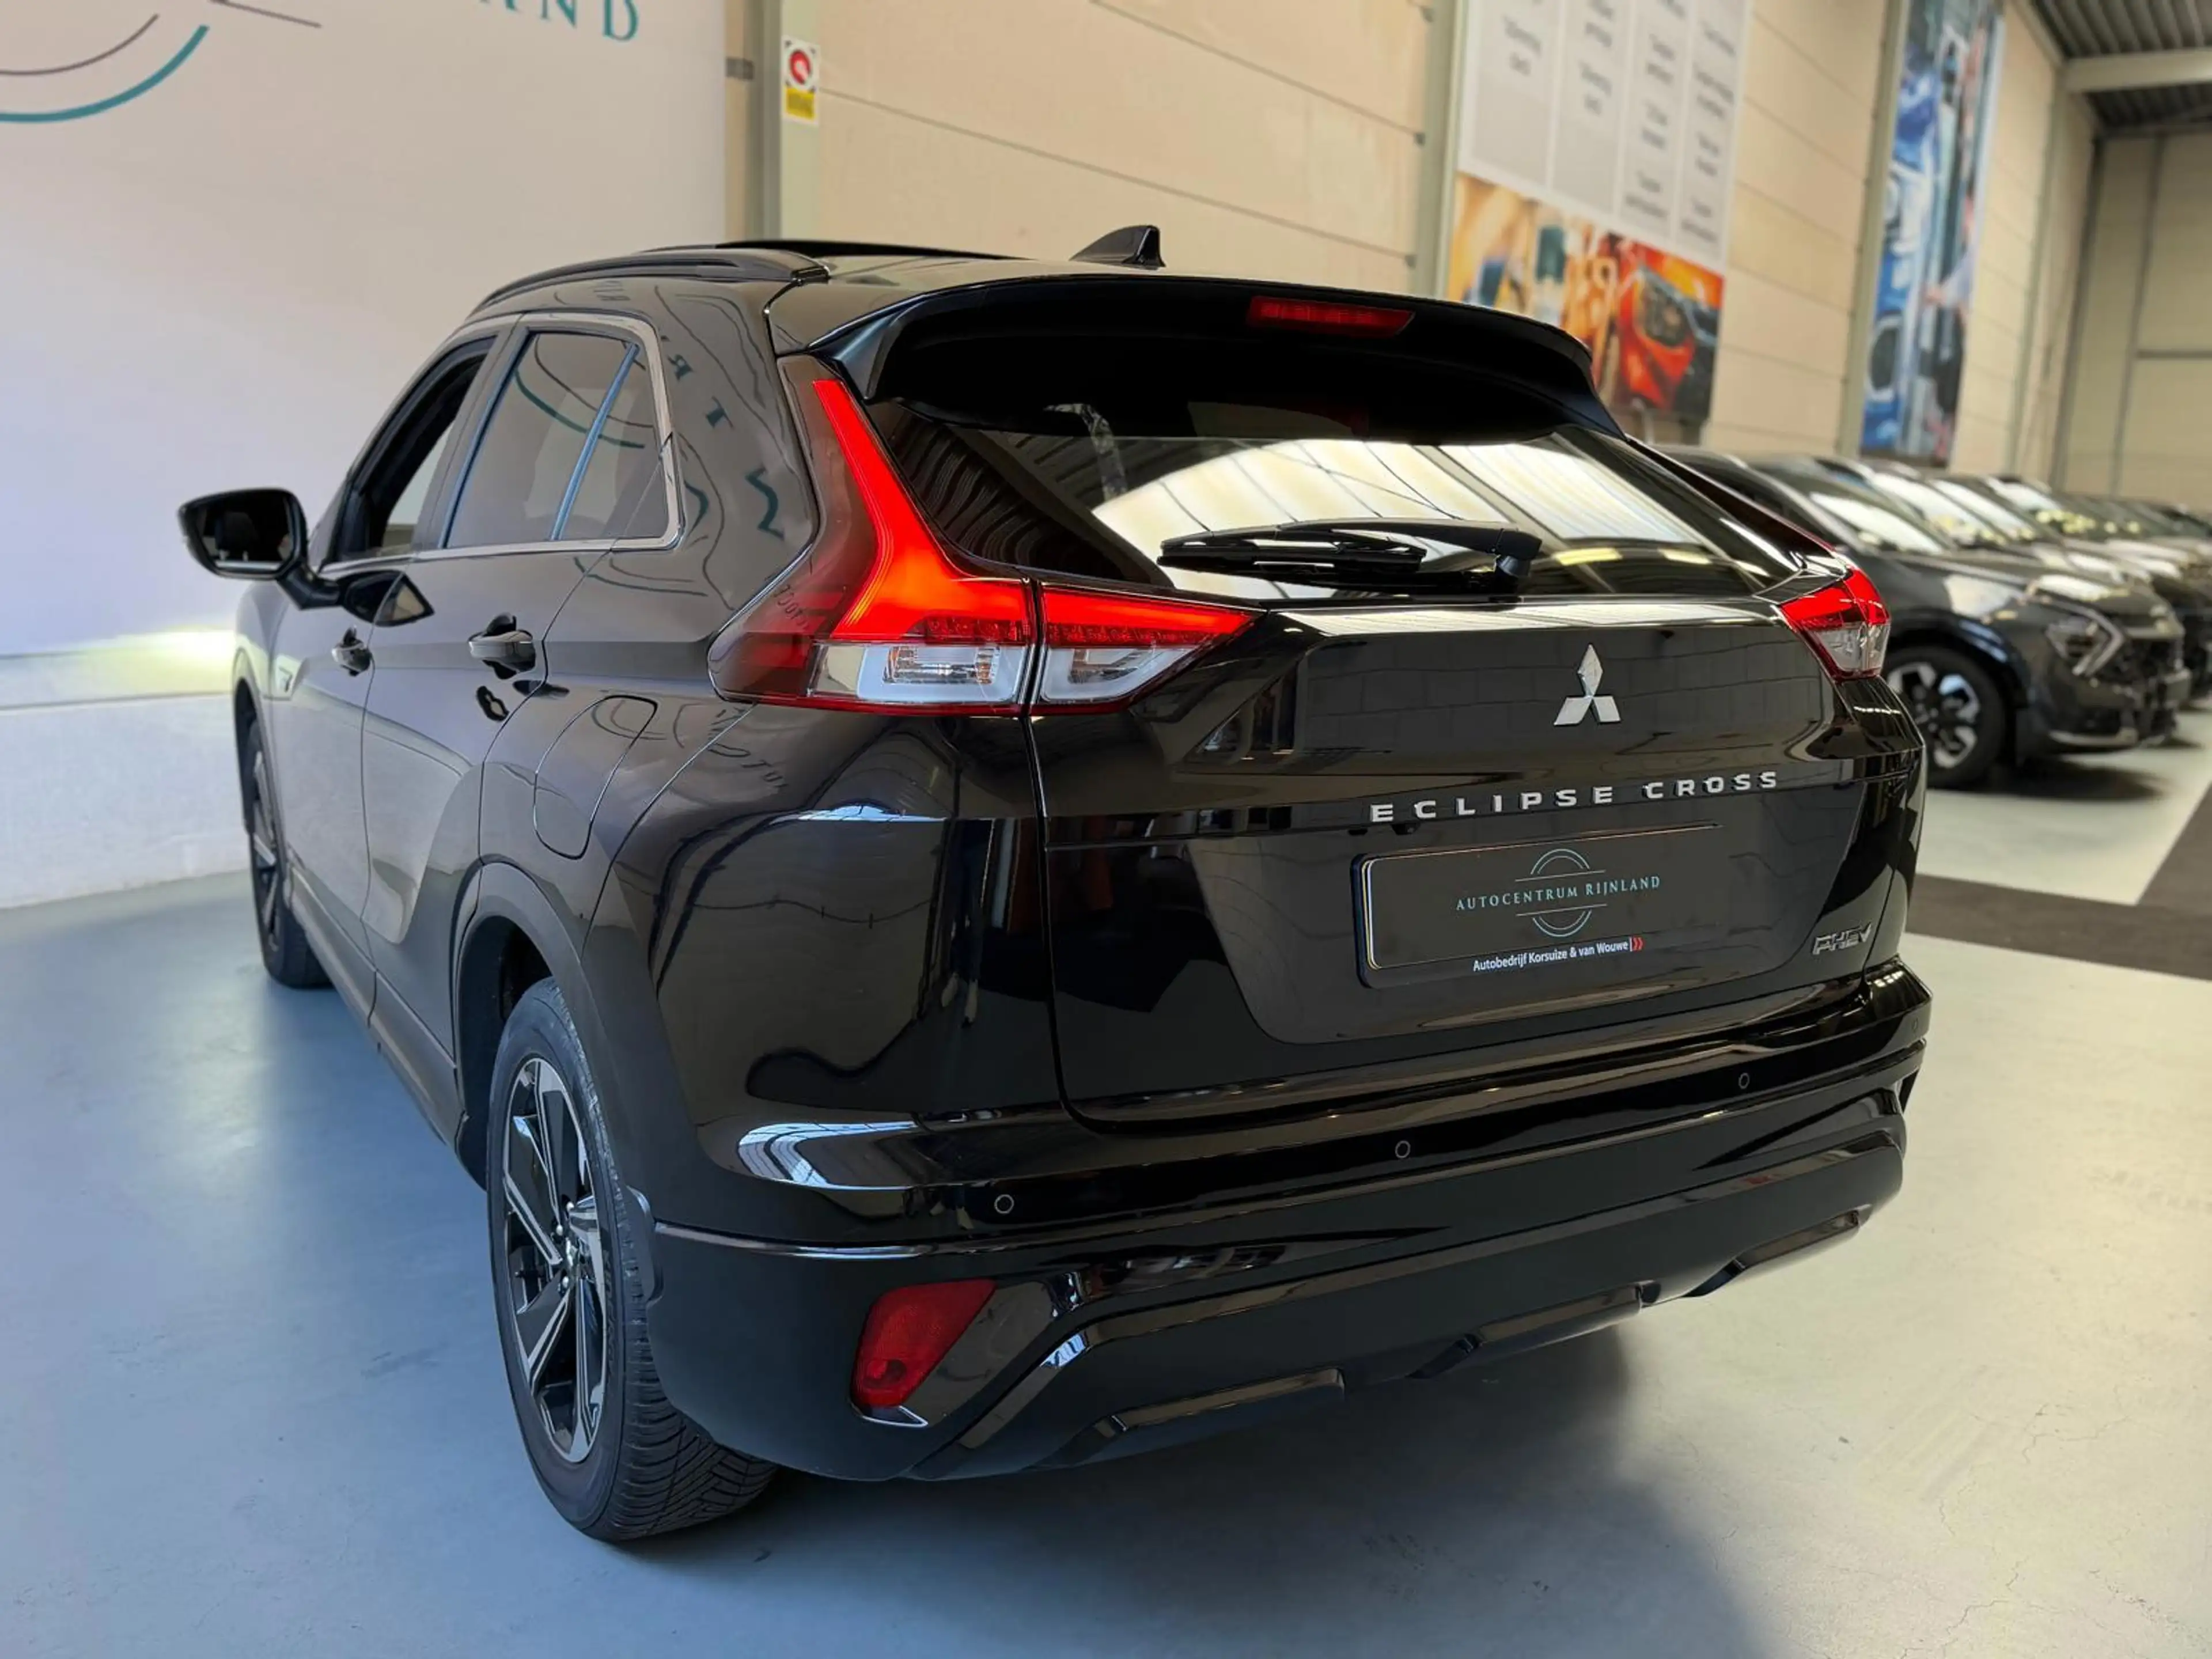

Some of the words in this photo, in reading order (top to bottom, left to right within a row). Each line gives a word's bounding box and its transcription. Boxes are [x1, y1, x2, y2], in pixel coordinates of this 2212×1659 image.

[1370, 786, 1613, 823] ECLIPSE
[1643, 771, 1777, 799] CROSS
[1456, 886, 1578, 911] AUTOCENTRUM
[1585, 876, 1661, 897] RIJNLAND
[1812, 922, 1872, 955] PHEV
[1473, 952, 1528, 972] Autobedrijf
[1528, 948, 1567, 964] Korsuize
[1570, 946, 1577, 958] &
[1579, 946, 1595, 957] van
[1597, 941, 1628, 955] Wouwe
